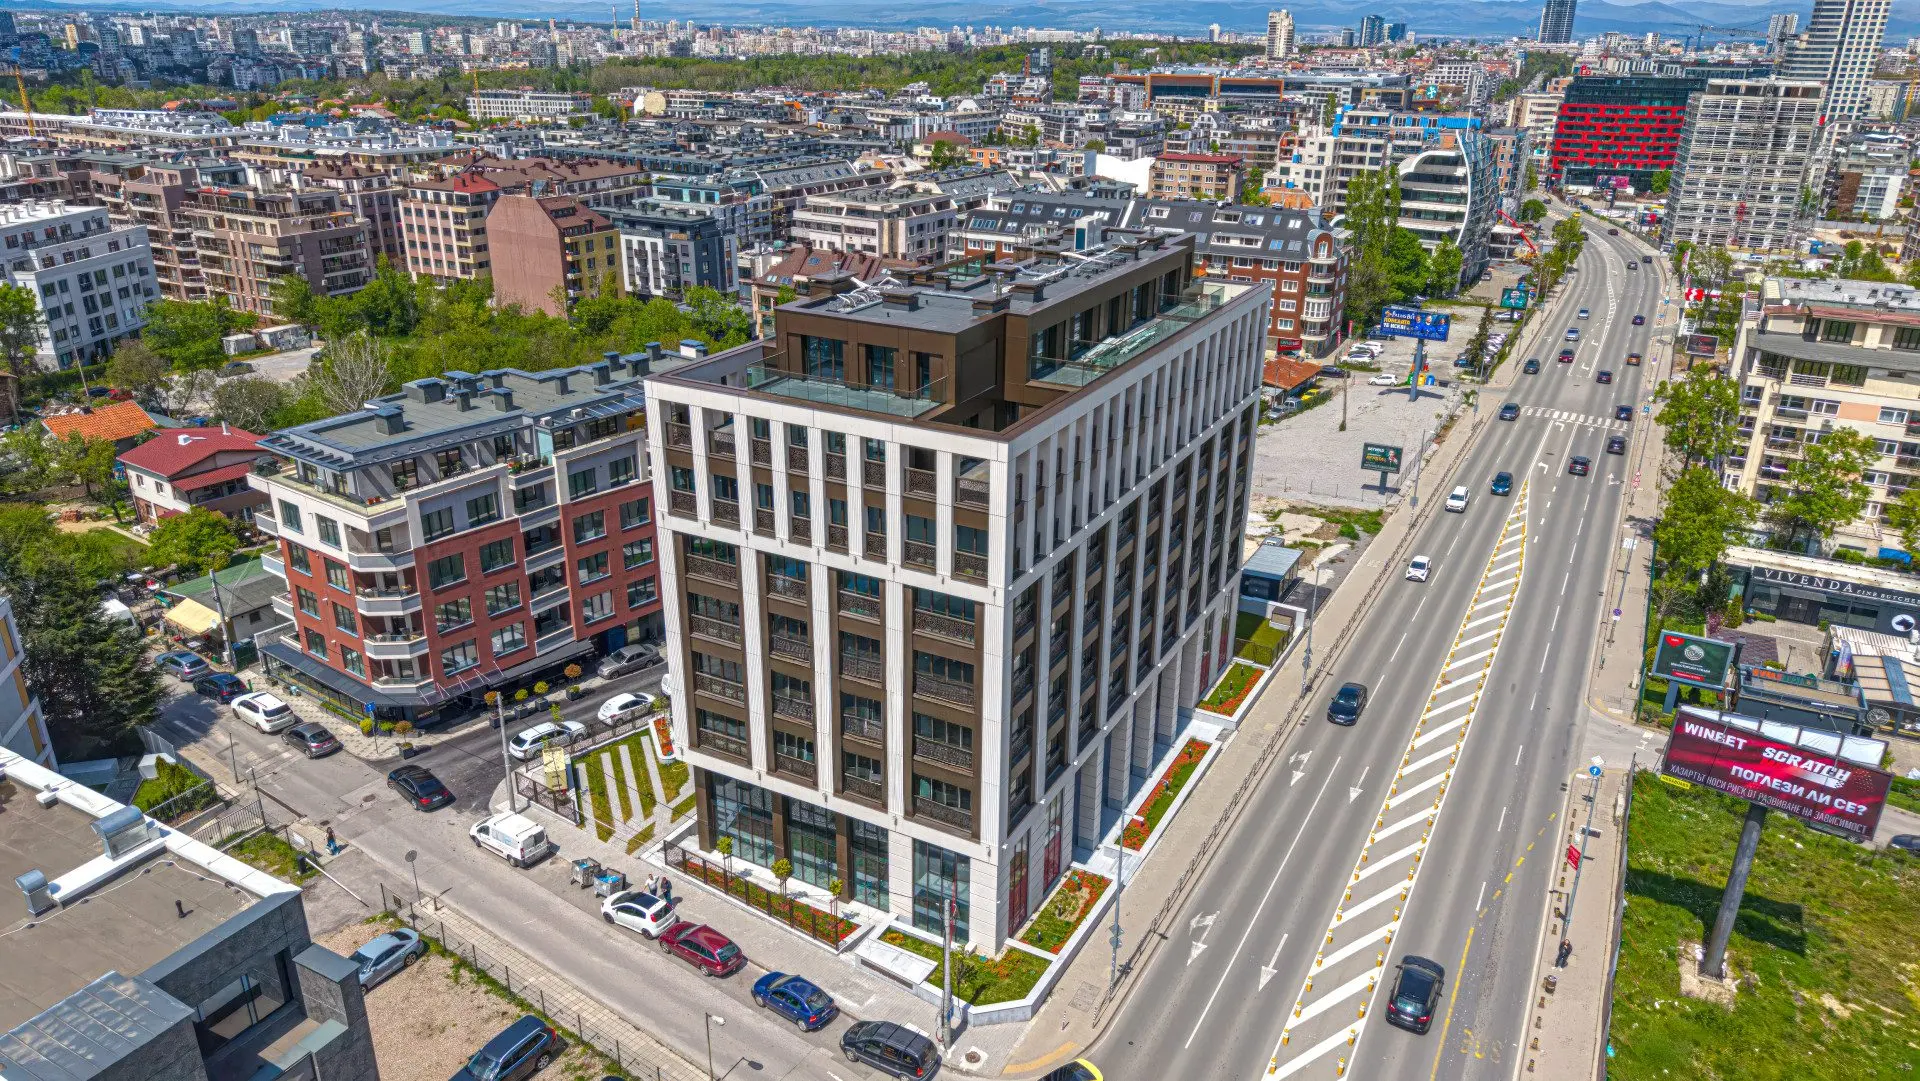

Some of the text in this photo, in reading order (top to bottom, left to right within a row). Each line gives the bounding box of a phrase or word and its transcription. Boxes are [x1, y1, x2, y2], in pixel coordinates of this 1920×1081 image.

[1764, 569, 1853, 593] VIVENDA
[1684, 721, 1747, 749] WINBET
[1762, 747, 1852, 781] SCRATCH
[1669, 764, 1868, 835] ХАЗАРТЪТ НОСИ РИСК ОТ РАЗВИВАНЕ НА ЗАВИСИМОСТ
[1730, 765, 1868, 816] ПОГЛЕЗИ ЛИ СЕ?
